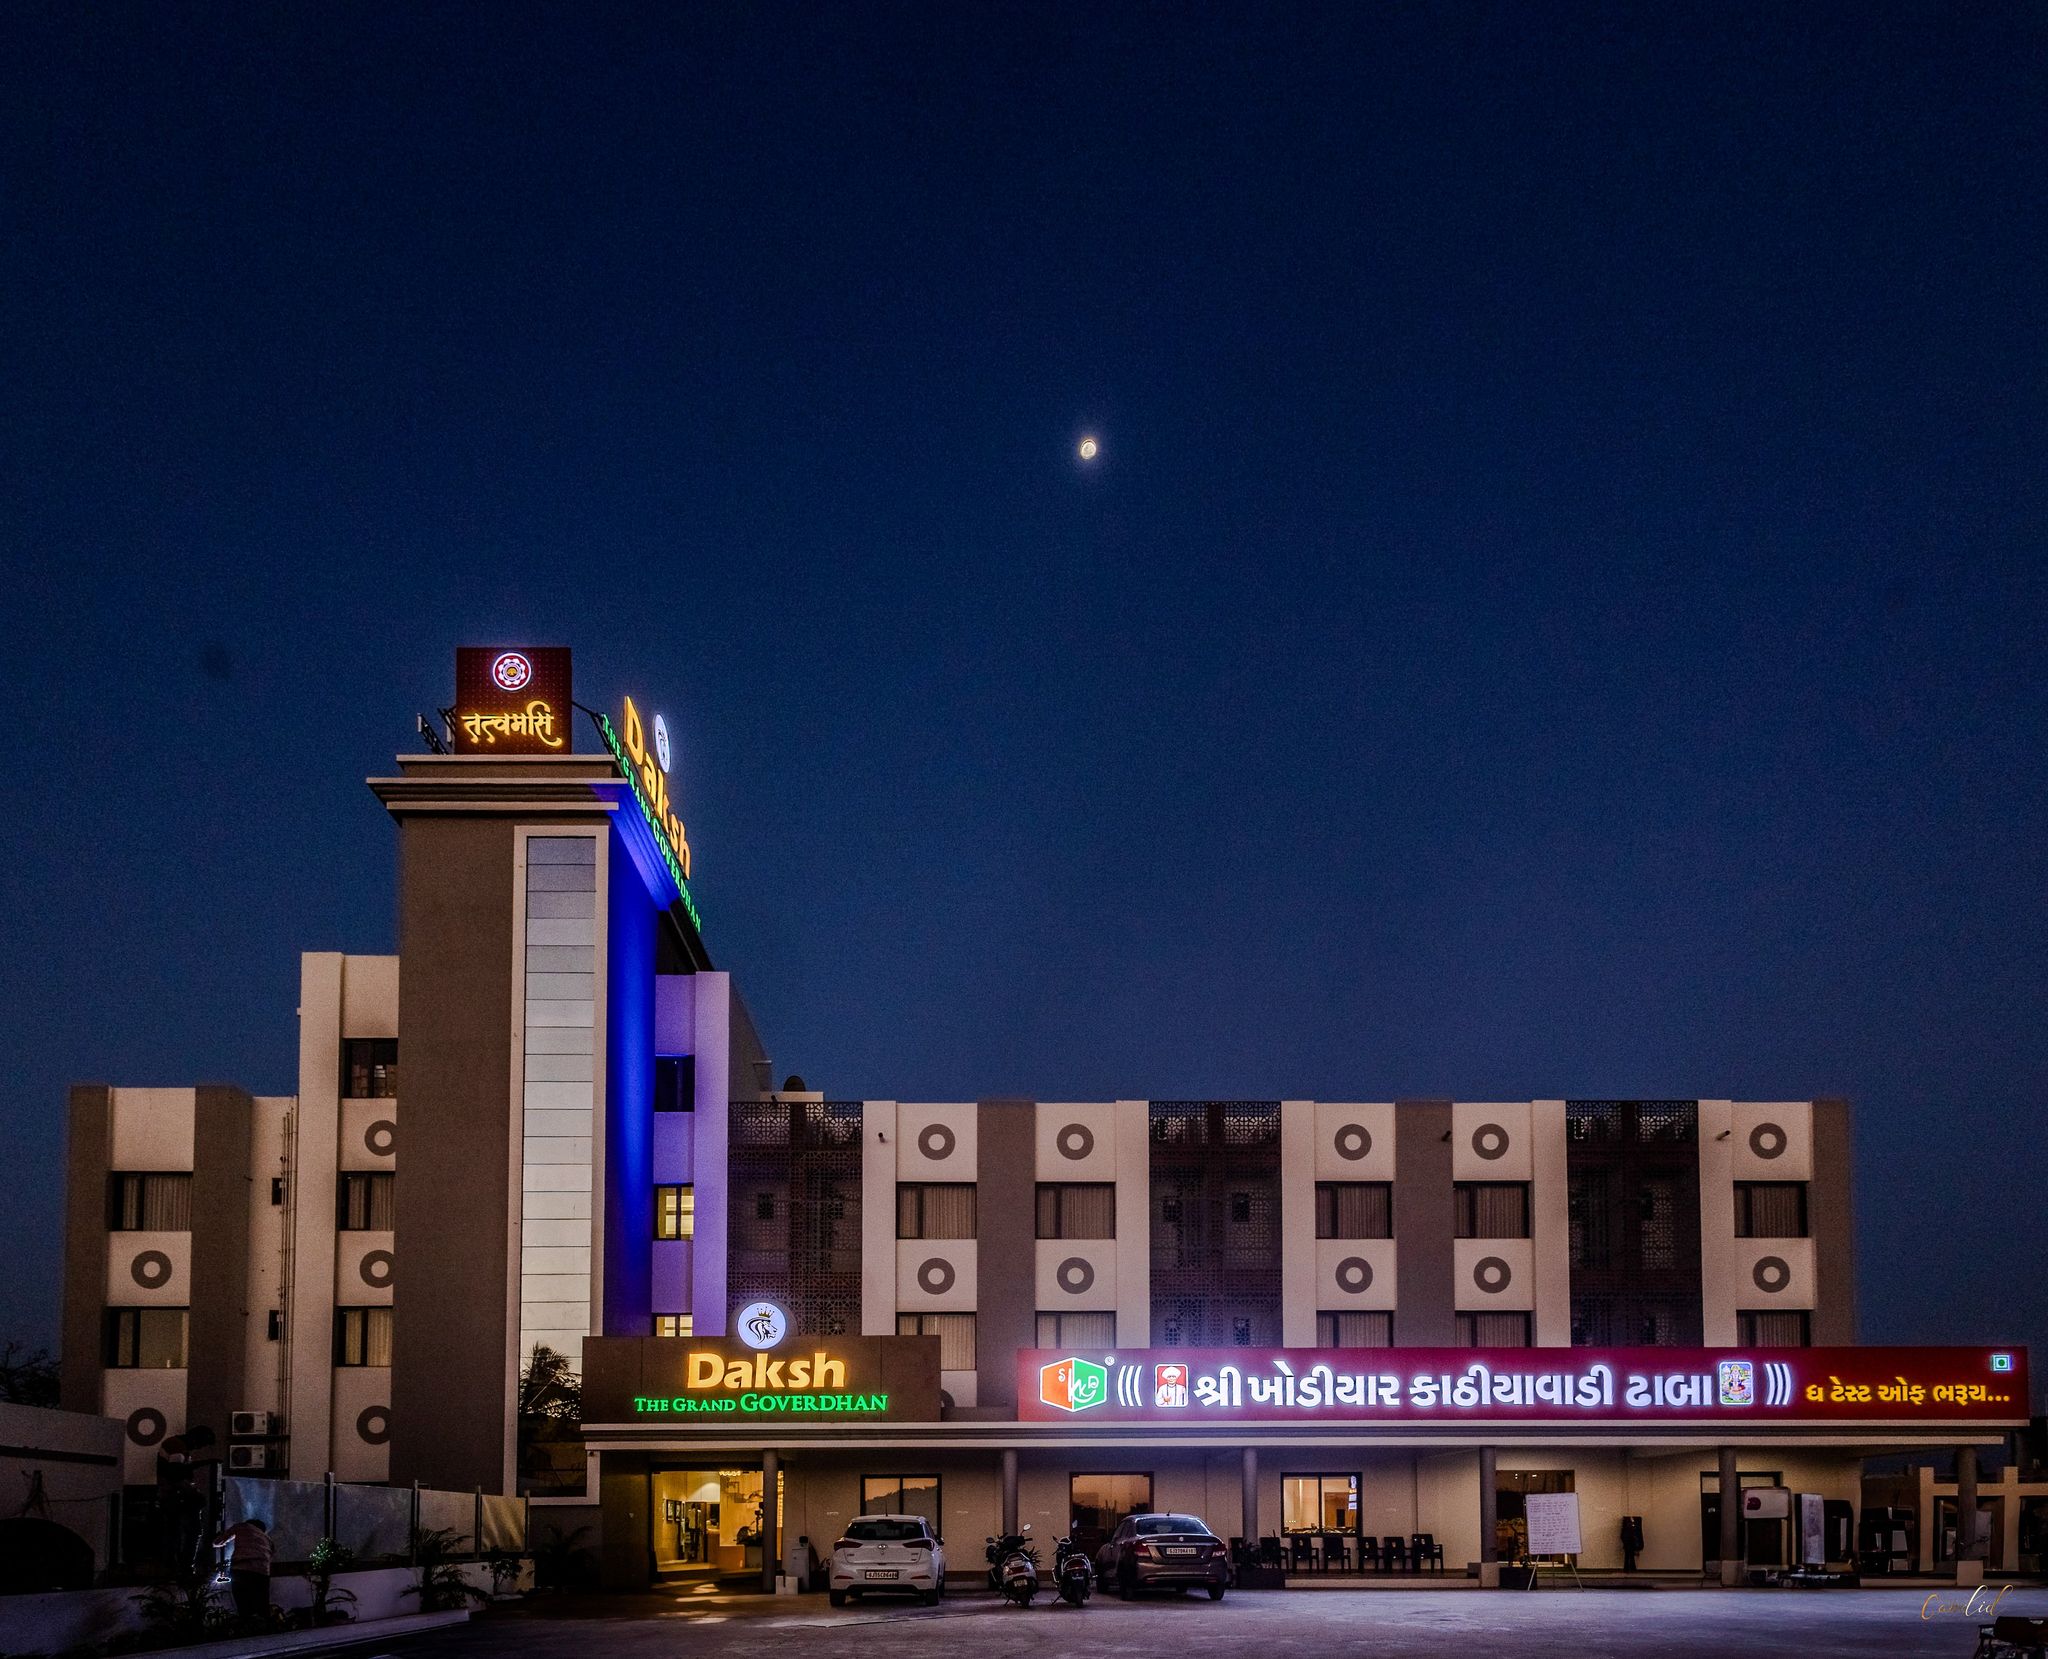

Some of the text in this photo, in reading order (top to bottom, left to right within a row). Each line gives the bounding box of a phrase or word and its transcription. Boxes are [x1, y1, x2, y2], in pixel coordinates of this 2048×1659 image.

[623, 696, 691, 879] Daksh
[602, 714, 702, 934] THE GRAND GOVERDHAN
[687, 1352, 846, 1389] Daksh
[1193, 1360, 1713, 1407] શ્રી ખોડીયાર કાઠીયાવાડી ઢાબા
[1806, 1384, 1824, 1402] ધ
[1830, 1376, 1872, 1402] ટેસ્ટ
[1877, 1376, 1926, 1405] ઓફ
[633, 1393, 889, 1412] THE GRAND GOVERDHAN
